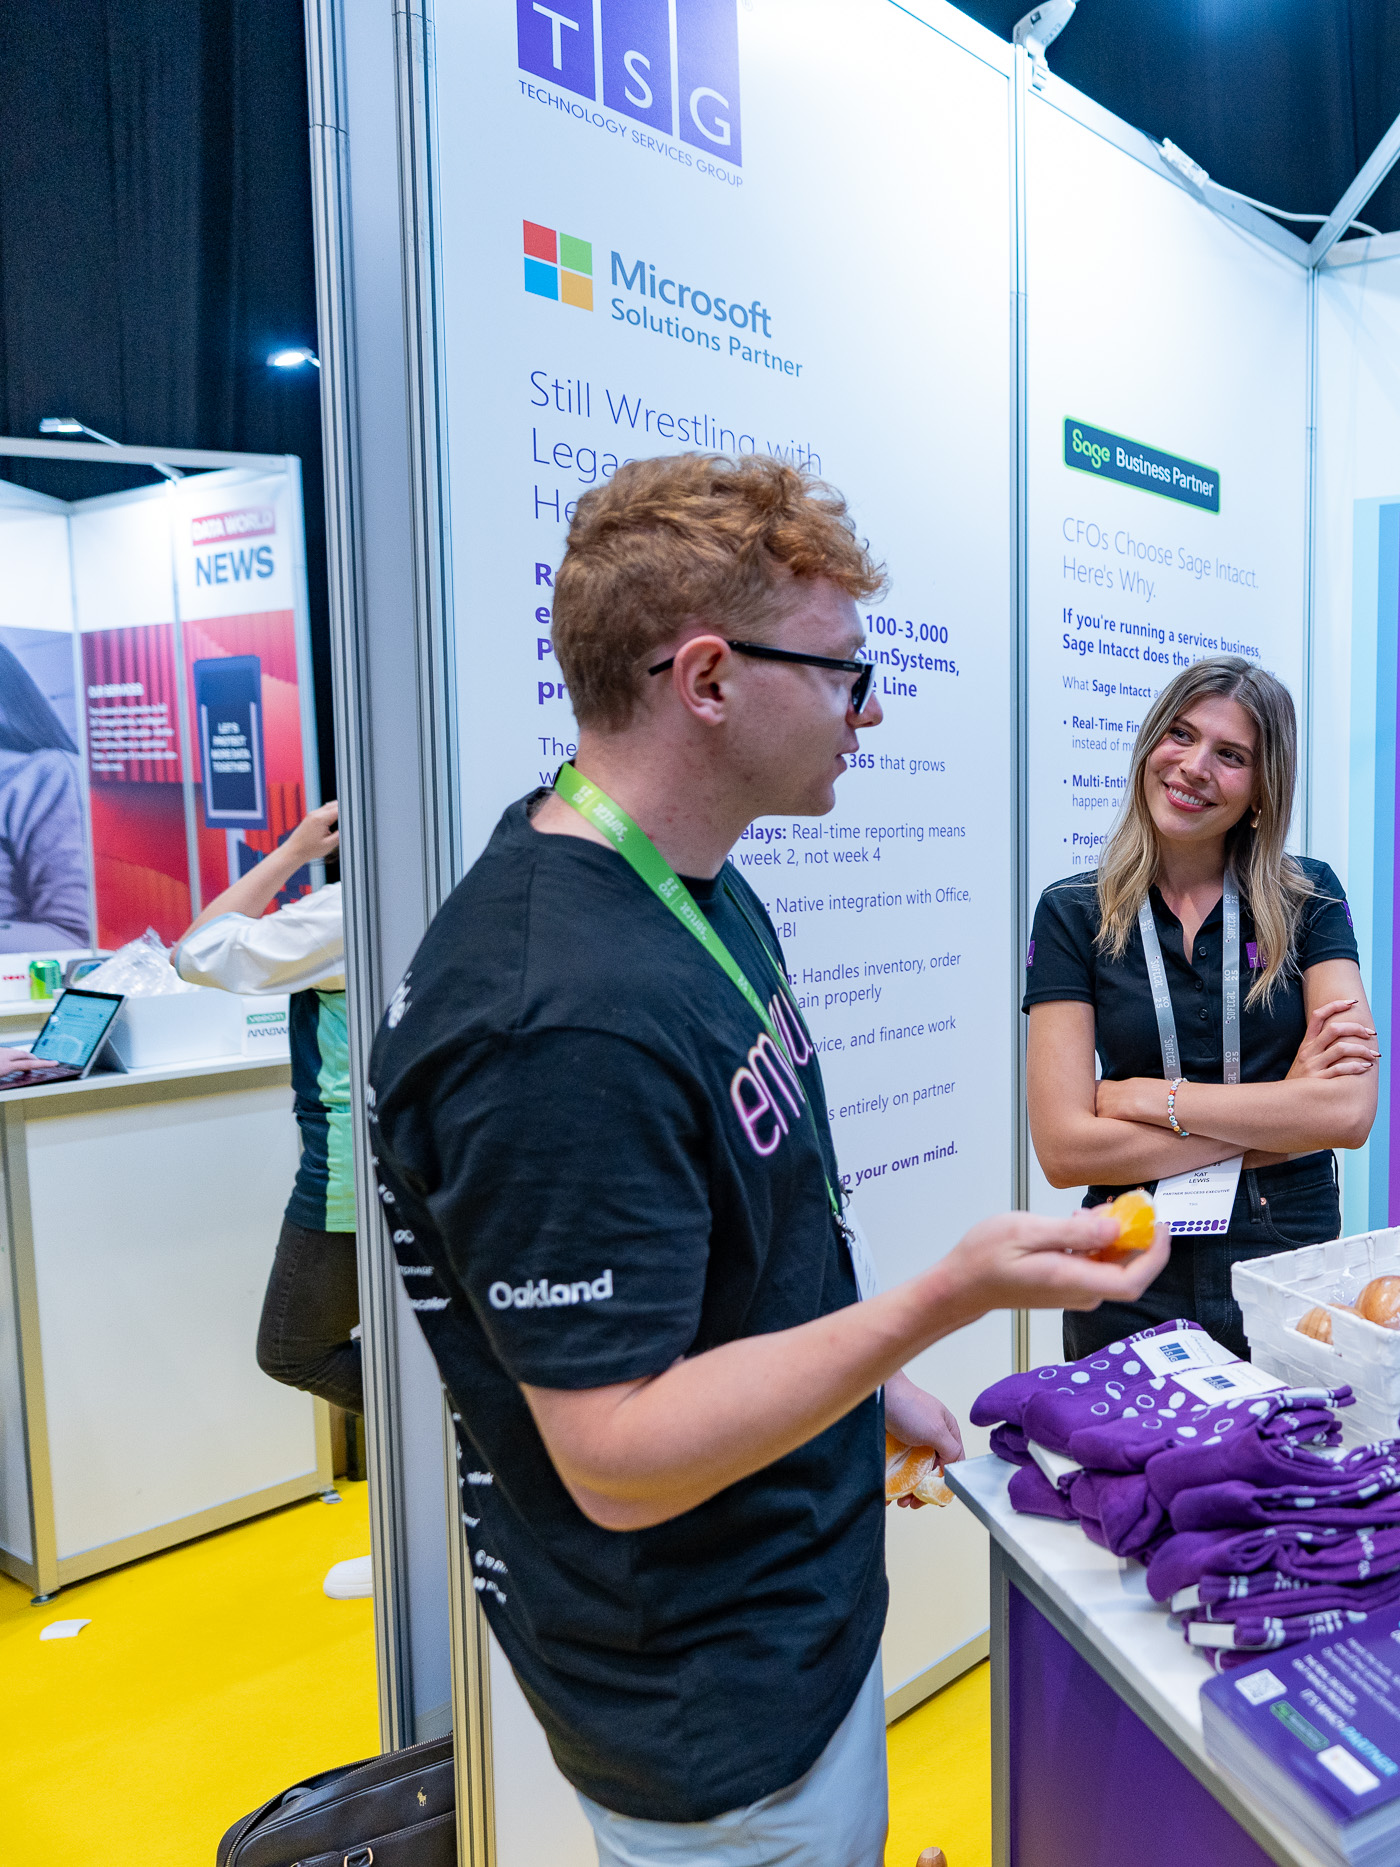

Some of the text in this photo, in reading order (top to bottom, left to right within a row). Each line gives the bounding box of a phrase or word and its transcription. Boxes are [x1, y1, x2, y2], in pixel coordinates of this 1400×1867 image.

[532, 1, 731, 146] TSG
[518, 79, 744, 189] TECHNOLOGY SERVICES GROUP
[610, 249, 772, 339] Microsoft
[611, 297, 803, 378] Solutions Partner
[530, 370, 592, 418] Still
[605, 388, 756, 455] Wrestling
[1072, 427, 1215, 497] Sage Business Partner
[196, 545, 275, 587] NEWS
[1062, 517, 1259, 589] CFOs Choose Sage Intacct.
[1063, 555, 1156, 603] Here's Why.
[865, 614, 949, 644] 100-3,000
[1063, 607, 1073, 624] If
[1076, 613, 1116, 632] you're
[1120, 619, 1165, 645] running
[1168, 630, 1175, 643] a
[1178, 632, 1218, 650] services
[1220, 636, 1262, 660] business,
[1062, 633, 1094, 656] Sage
[1098, 639, 1140, 660] Intacct
[1143, 646, 1170, 664] does
[1173, 651, 1190, 667] the
[883, 676, 918, 697] Line
[1062, 675, 1090, 692] What
[1092, 679, 1117, 698] Sage
[1119, 682, 1152, 698] Intacct
[1072, 715, 1124, 732] Real-Time
[1072, 736, 1107, 751] instead
[1110, 737, 1119, 752] of
[849, 754, 946, 776] 365 that grows
[1072, 793, 1109, 811] happen
[740, 822, 966, 844] elays: Real-time reporting means
[740, 848, 782, 866] week
[786, 848, 799, 867] 2,
[804, 849, 829, 864] not
[833, 847, 868, 863] week
[872, 847, 881, 862] 4
[1072, 852, 1082, 865] in
[776, 887, 972, 914] Native integration with Office,
[802, 963, 860, 985] Handles
[864, 955, 927, 979] inventory,
[930, 952, 962, 969] order
[824, 983, 882, 1010] properly
[850, 1028, 875, 1047] and
[879, 1024, 925, 1044] finance
[927, 1014, 957, 1032] work
[839, 1094, 889, 1120] entirely
[892, 1092, 909, 1107] on
[912, 1080, 956, 1103] partner
[855, 1141, 959, 1187] your own mind.
[489, 1268, 613, 1310] Oakland
